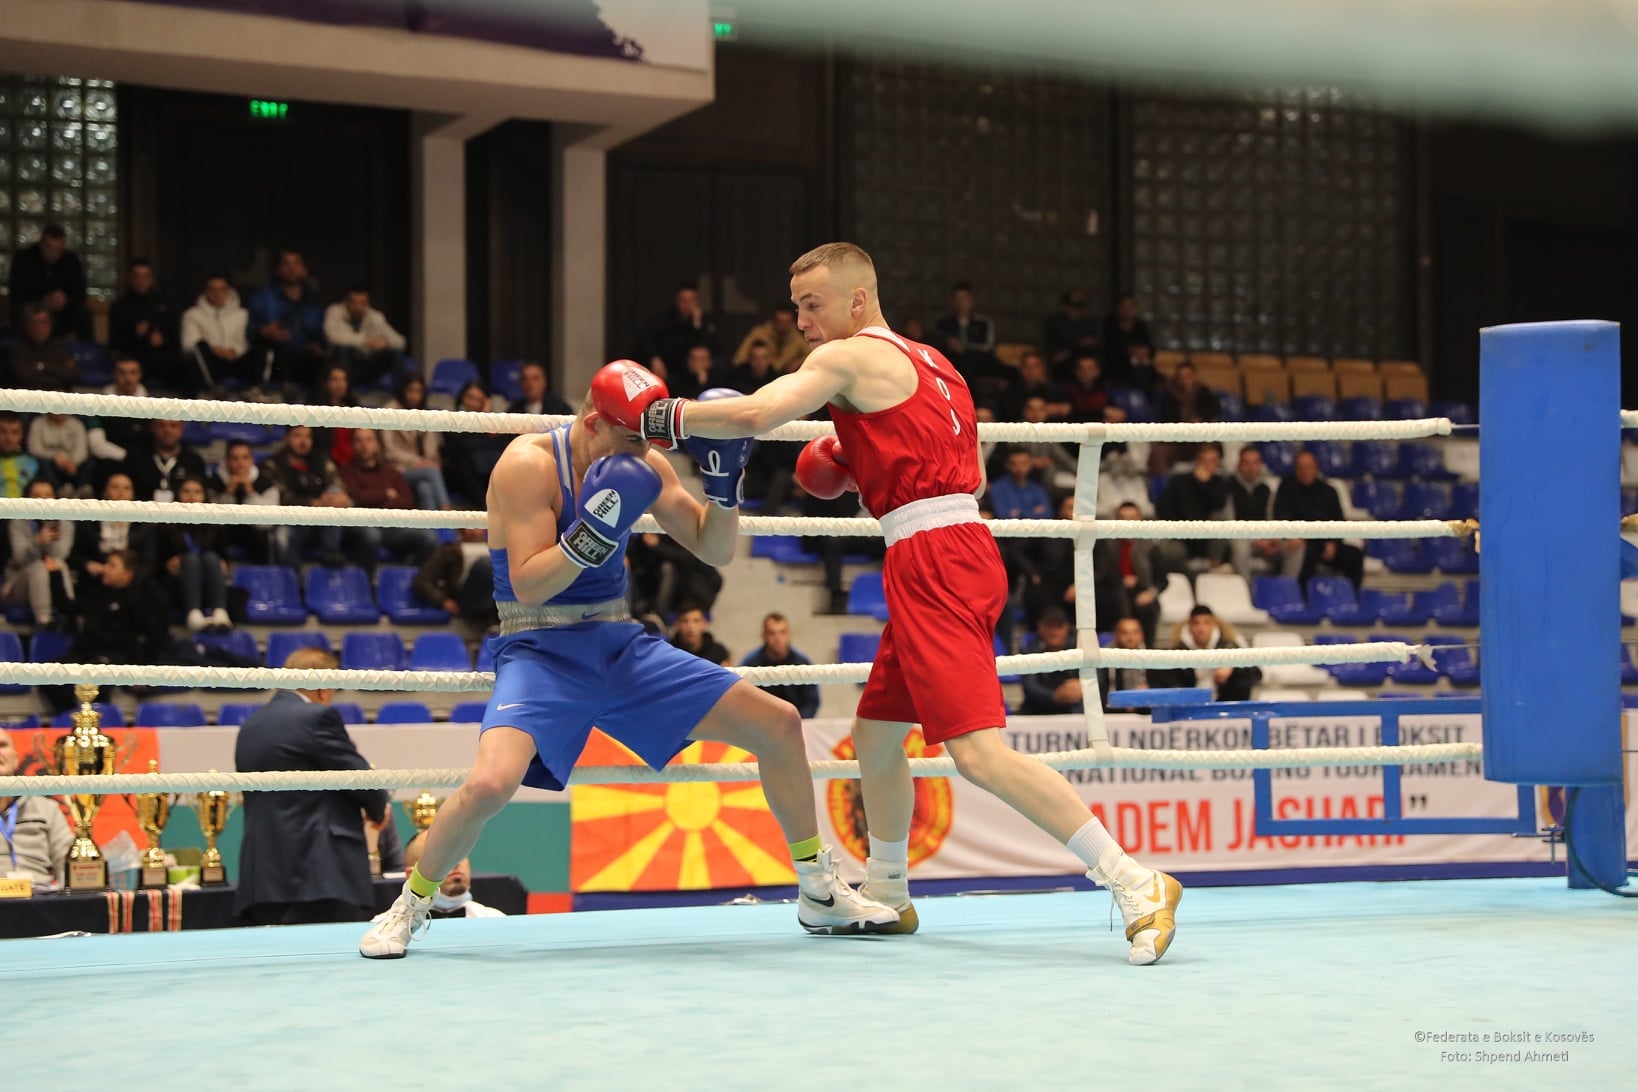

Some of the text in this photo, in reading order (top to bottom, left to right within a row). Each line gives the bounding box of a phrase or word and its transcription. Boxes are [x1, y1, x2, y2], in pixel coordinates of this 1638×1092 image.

[656, 401, 669, 434] HILL
[593, 490, 616, 515] GREEN
[597, 500, 618, 519] HILL
[573, 537, 598, 560] HILL
